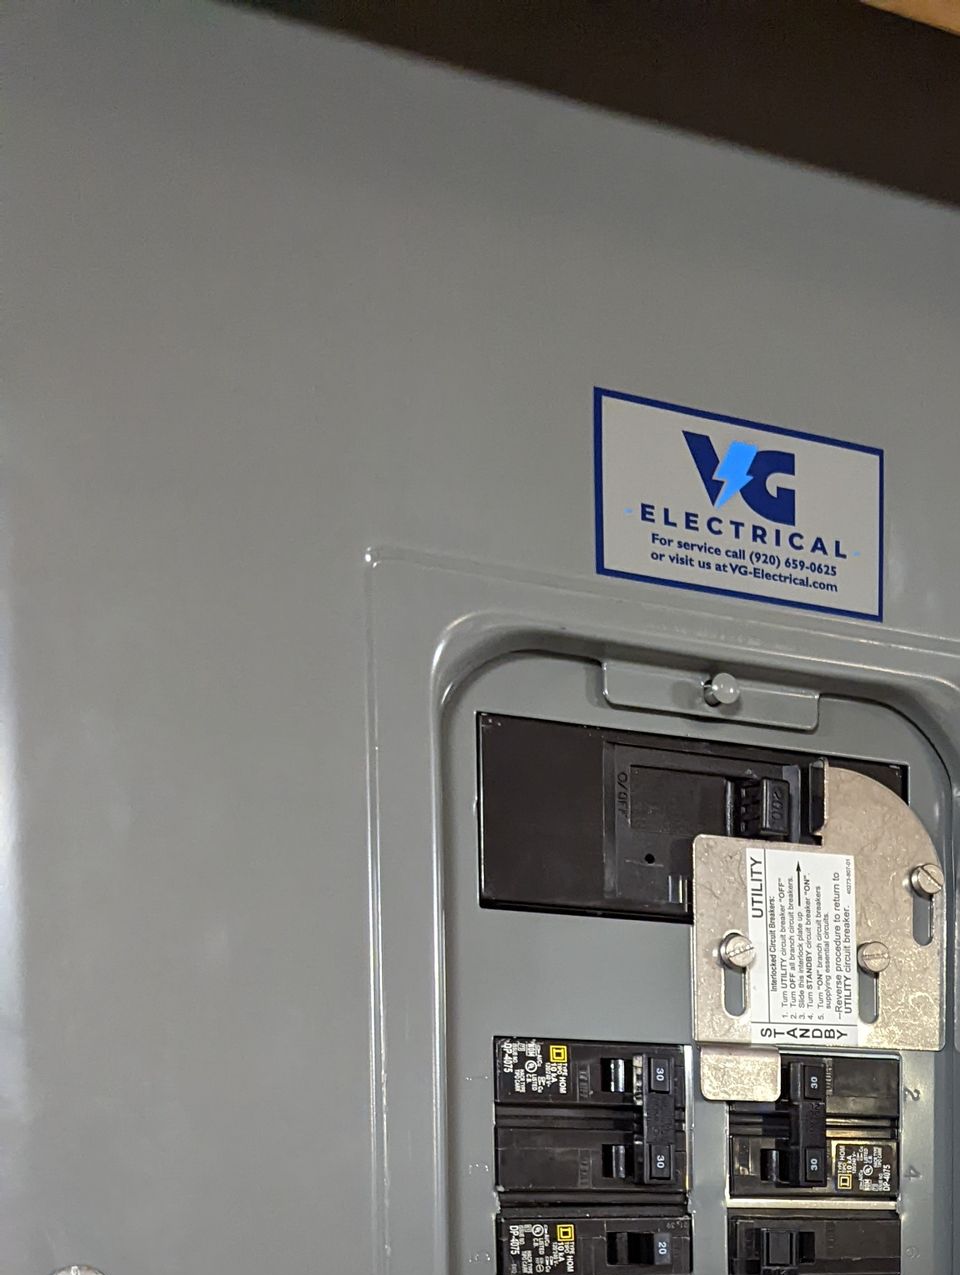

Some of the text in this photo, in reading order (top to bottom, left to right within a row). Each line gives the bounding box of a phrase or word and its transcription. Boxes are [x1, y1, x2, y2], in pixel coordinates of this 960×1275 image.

[640, 502, 848, 559] ELECTRICAL
[651, 532, 838, 577] For service call (920) 659-0625
[650, 551, 839, 592] or visit us at VG-Electrical.com
[750, 856, 764, 918] UTILITY
[833, 882, 841, 911] return
[834, 924, 844, 972] procedure
[843, 944, 851, 973] circuit
[844, 976, 852, 1014] UTILITY
[761, 1027, 847, 1039] STANDBY
[655, 1067, 664, 1082] 30
[810, 1076, 818, 1090] 30
[810, 1158, 818, 1172] 30
[658, 1241, 667, 1255] 20
